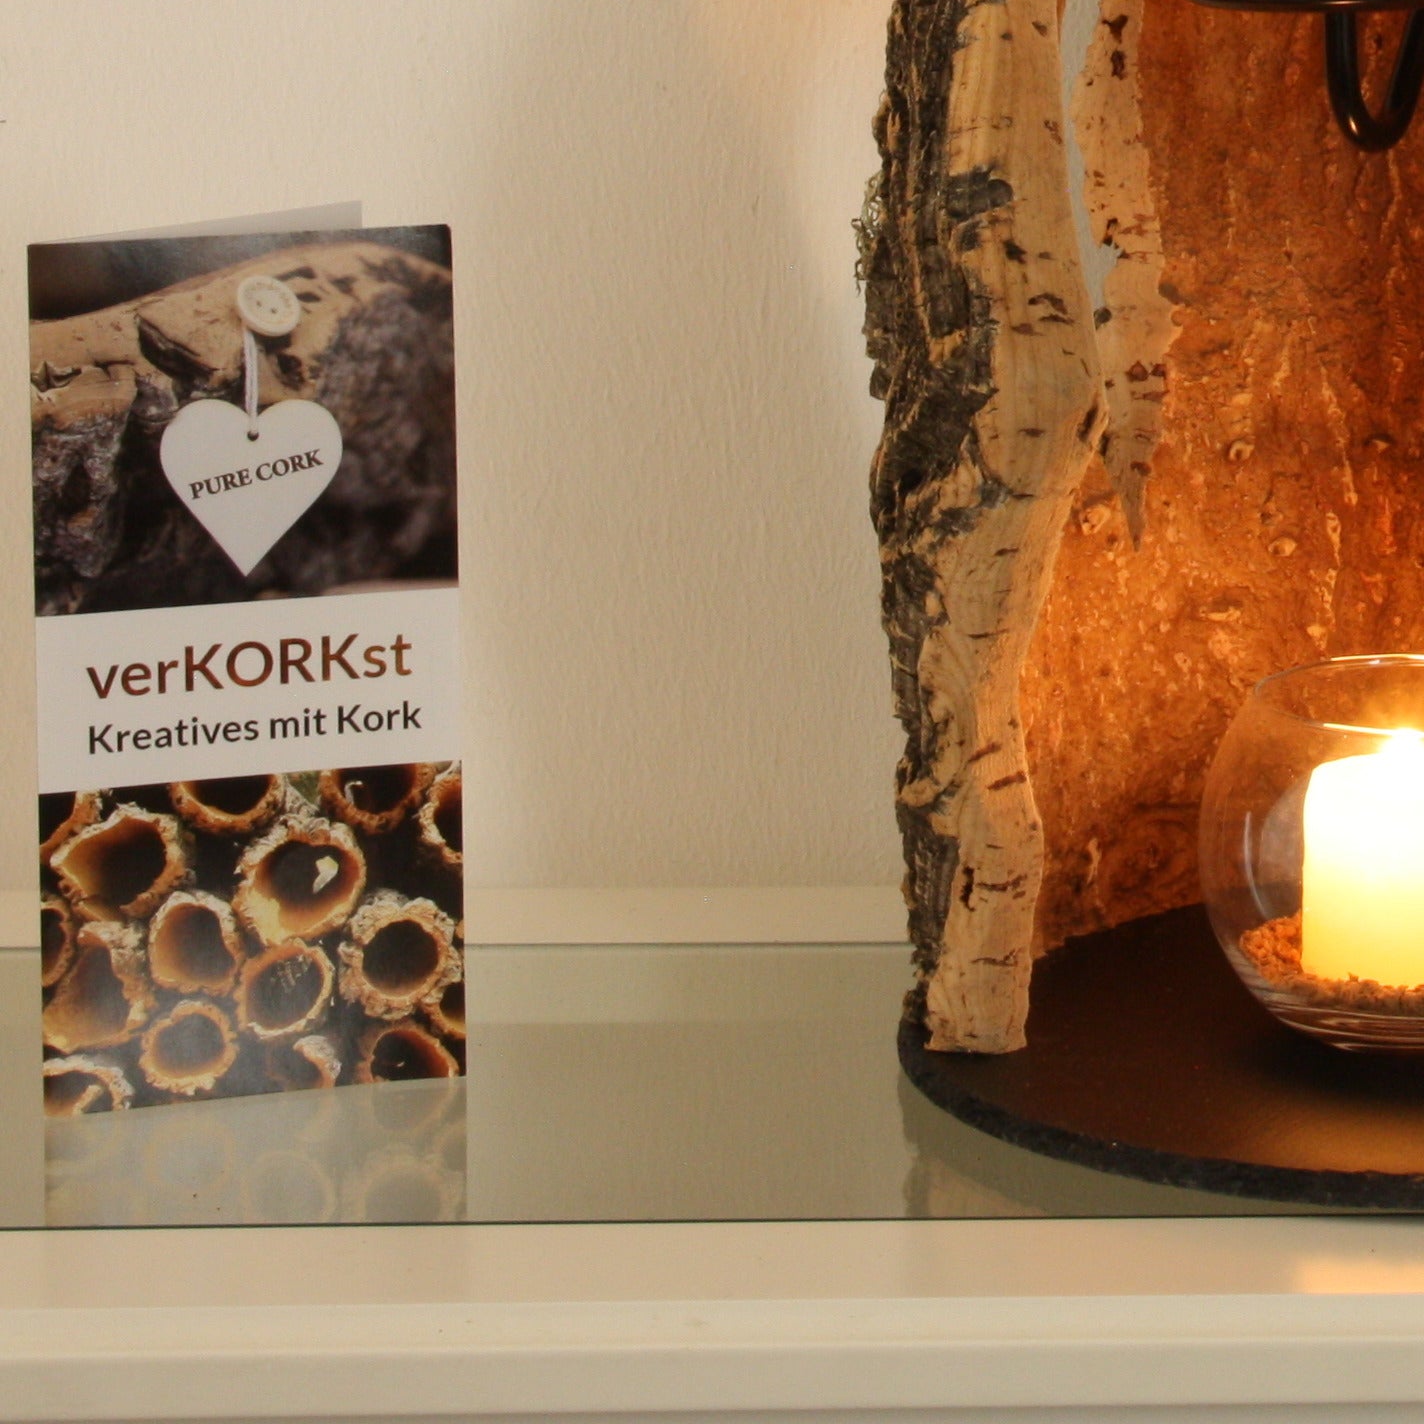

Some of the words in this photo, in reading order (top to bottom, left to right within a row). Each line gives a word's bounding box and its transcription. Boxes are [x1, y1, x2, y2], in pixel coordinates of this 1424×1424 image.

[188, 462, 252, 500] PURE
[255, 448, 323, 483] CORK
[86, 632, 412, 700] verKORKst
[87, 718, 259, 755] Kreatives
[269, 708, 327, 740] mit
[337, 700, 422, 734] Kork
